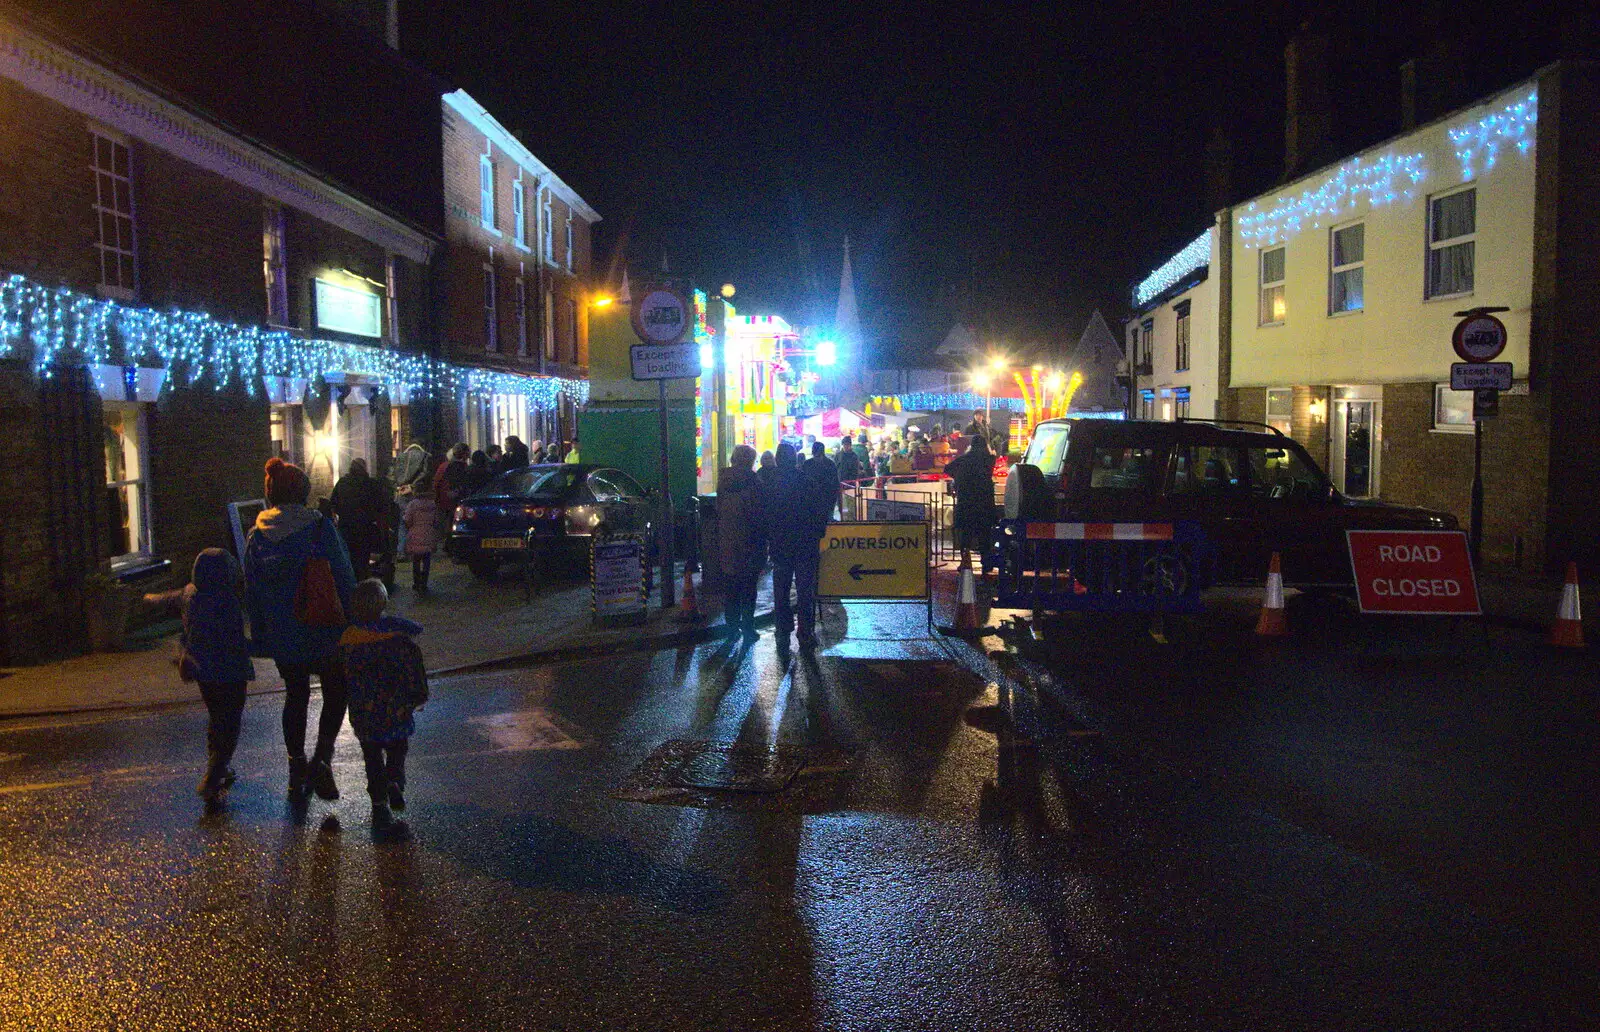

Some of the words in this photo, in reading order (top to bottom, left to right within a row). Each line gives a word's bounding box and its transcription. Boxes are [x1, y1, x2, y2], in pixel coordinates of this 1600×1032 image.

[637, 350, 675, 360] Except
[647, 362, 688, 373] loading
[1456, 367, 1489, 376] Except
[1493, 367, 1507, 375] for
[1464, 376, 1498, 386] loading
[829, 537, 918, 549] DIVERSION
[1378, 545, 1441, 562] ROAD
[1372, 578, 1460, 596] CLOSED
